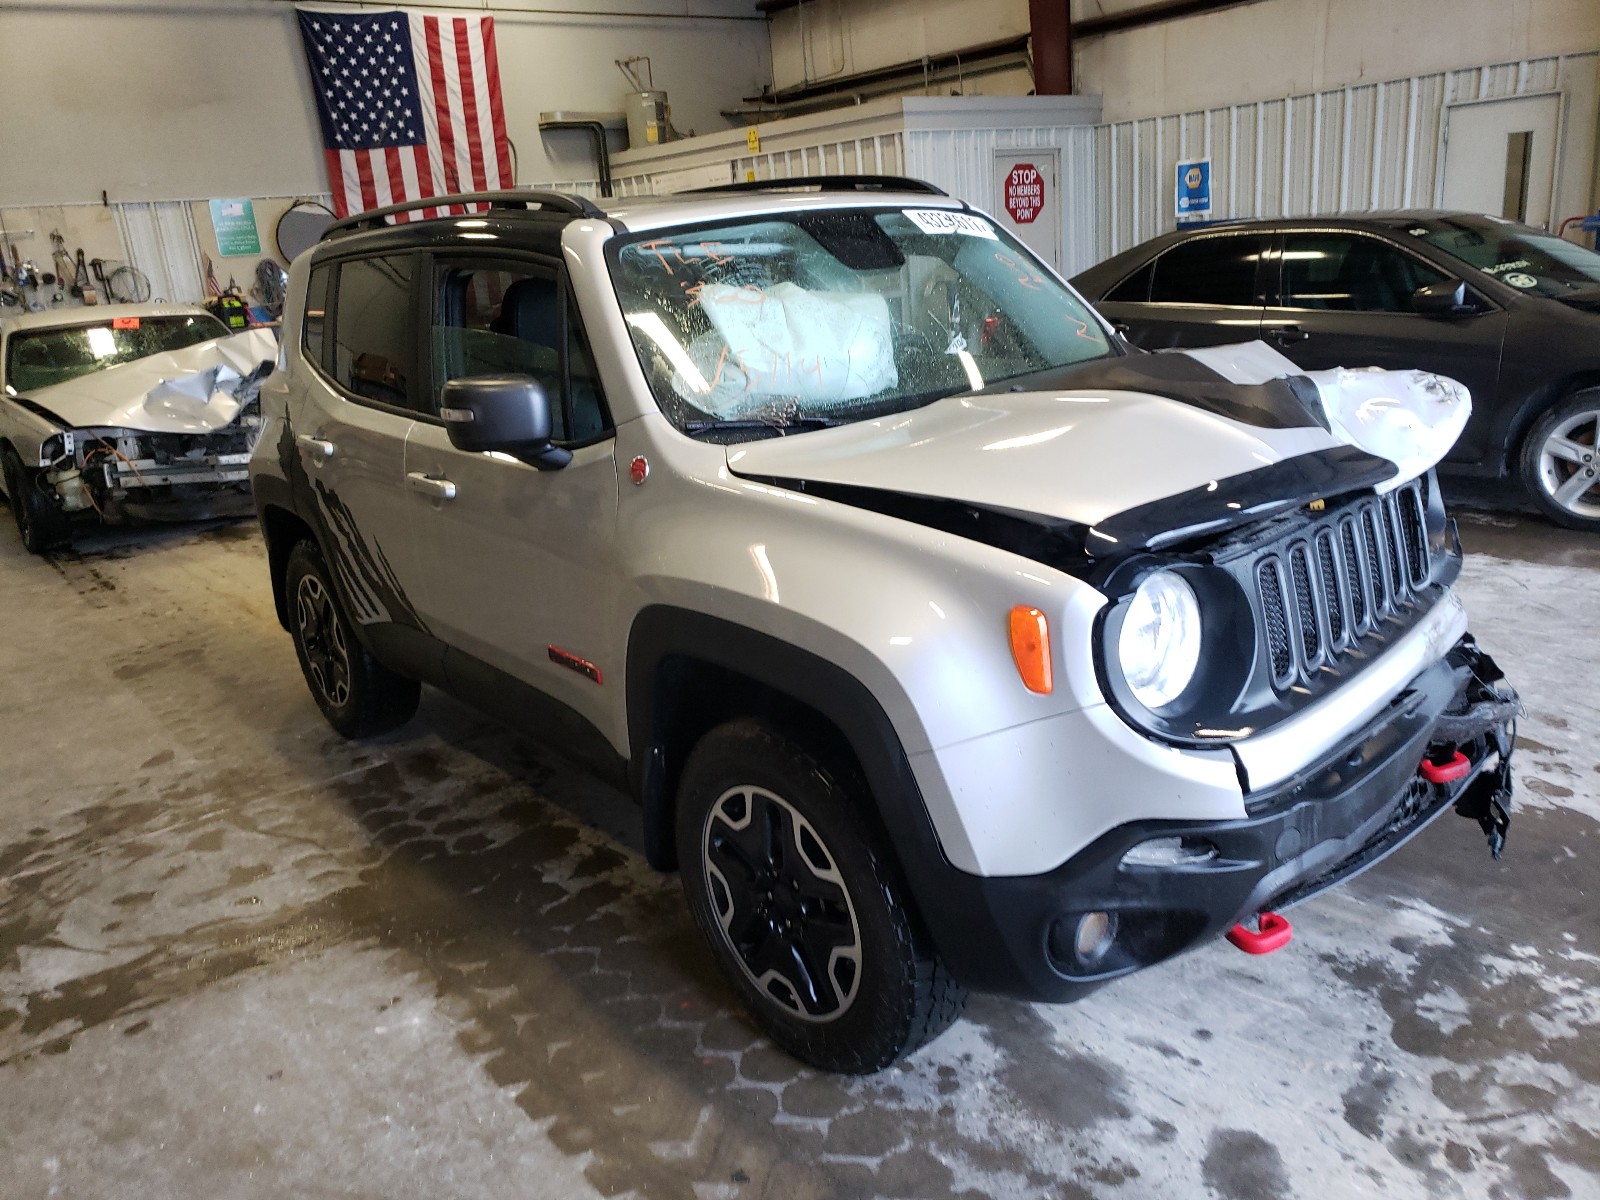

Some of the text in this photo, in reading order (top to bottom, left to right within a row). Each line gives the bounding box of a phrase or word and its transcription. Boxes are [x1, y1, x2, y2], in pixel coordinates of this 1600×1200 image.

[1012, 169, 1037, 185] STOP
[1009, 184, 1040, 197] NO MEMBERS
[1010, 195, 1040, 209] BEYOND THIS
[1016, 208, 1033, 220] POINT
